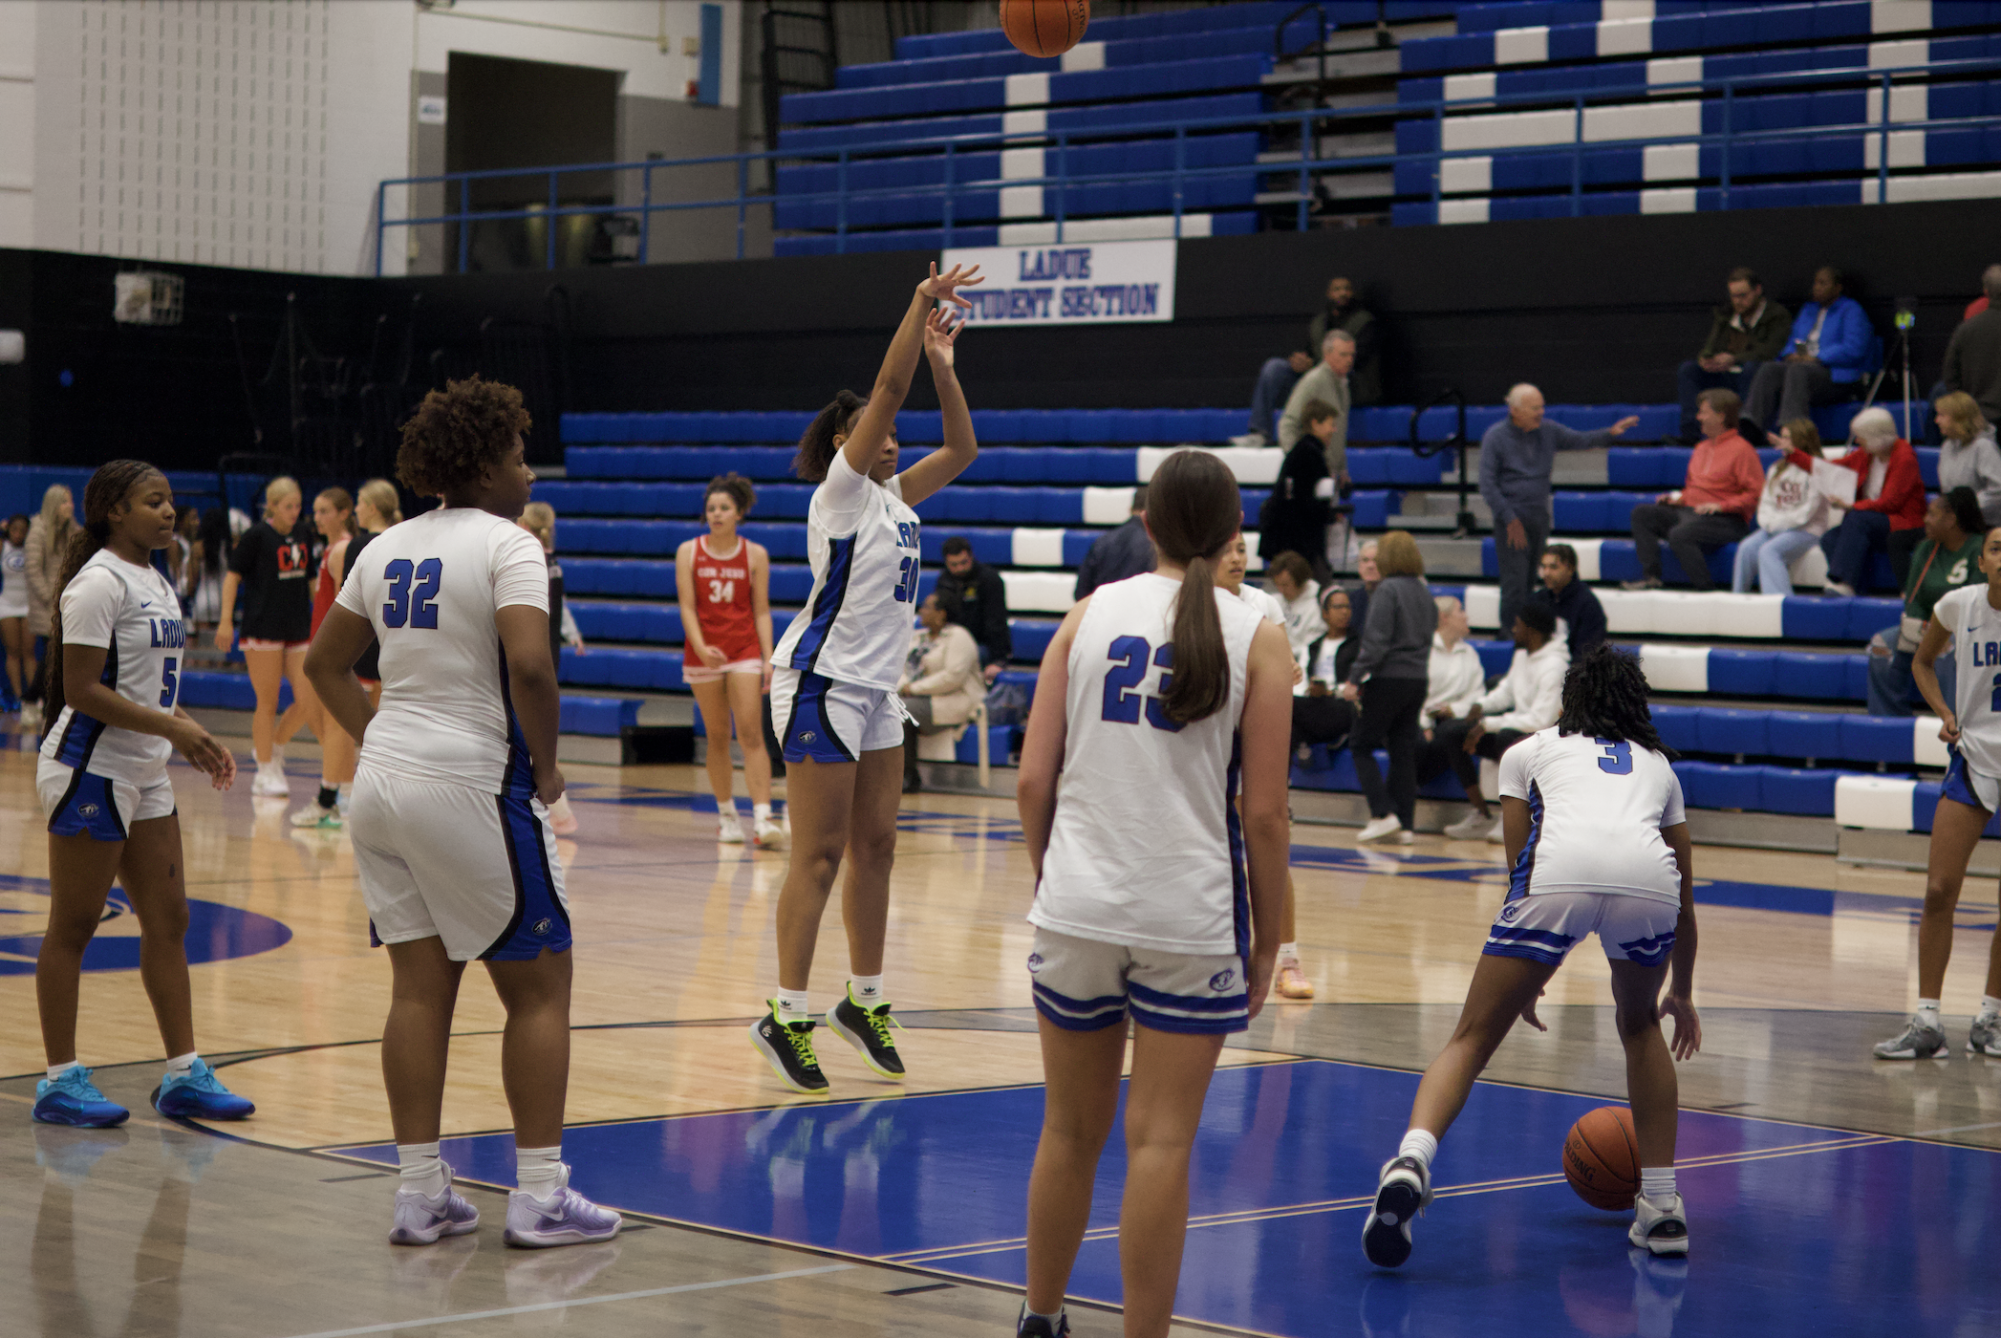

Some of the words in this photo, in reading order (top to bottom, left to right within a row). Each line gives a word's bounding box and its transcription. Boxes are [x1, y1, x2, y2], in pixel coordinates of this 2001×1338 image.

[1019, 249, 1091, 281] LADUE
[953, 287, 1054, 321] STUDENT
[1060, 283, 1159, 317] SECTION
[382, 558, 443, 630] 32
[709, 580, 734, 603] 34
[893, 556, 919, 603] 30
[159, 657, 177, 707] 5
[1101, 635, 1188, 733] 23
[1594, 737, 1633, 775] 3
